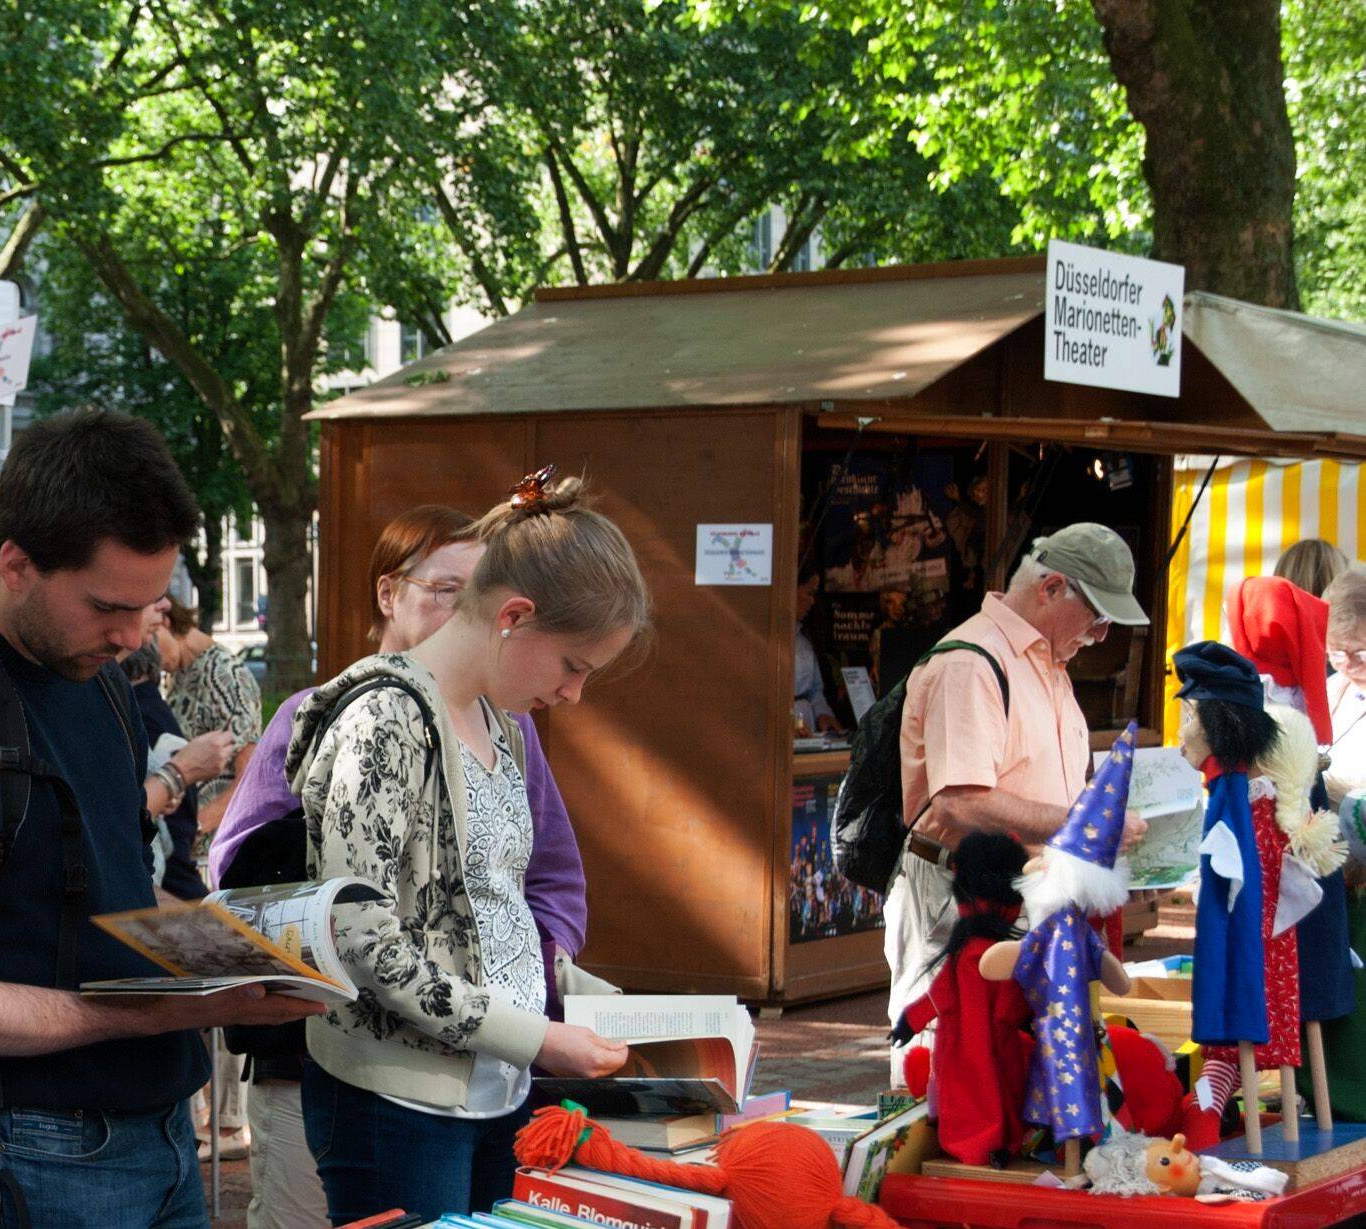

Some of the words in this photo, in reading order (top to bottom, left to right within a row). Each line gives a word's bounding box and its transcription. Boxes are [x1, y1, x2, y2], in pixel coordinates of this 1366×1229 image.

[1055, 260, 1143, 305] Düsseldorfer
[1054, 295, 1142, 339] Marionetten-
[1054, 331, 1108, 368] Theater
[528, 1190, 571, 1215] Kalle
[577, 1203, 667, 1229] Blomqui
